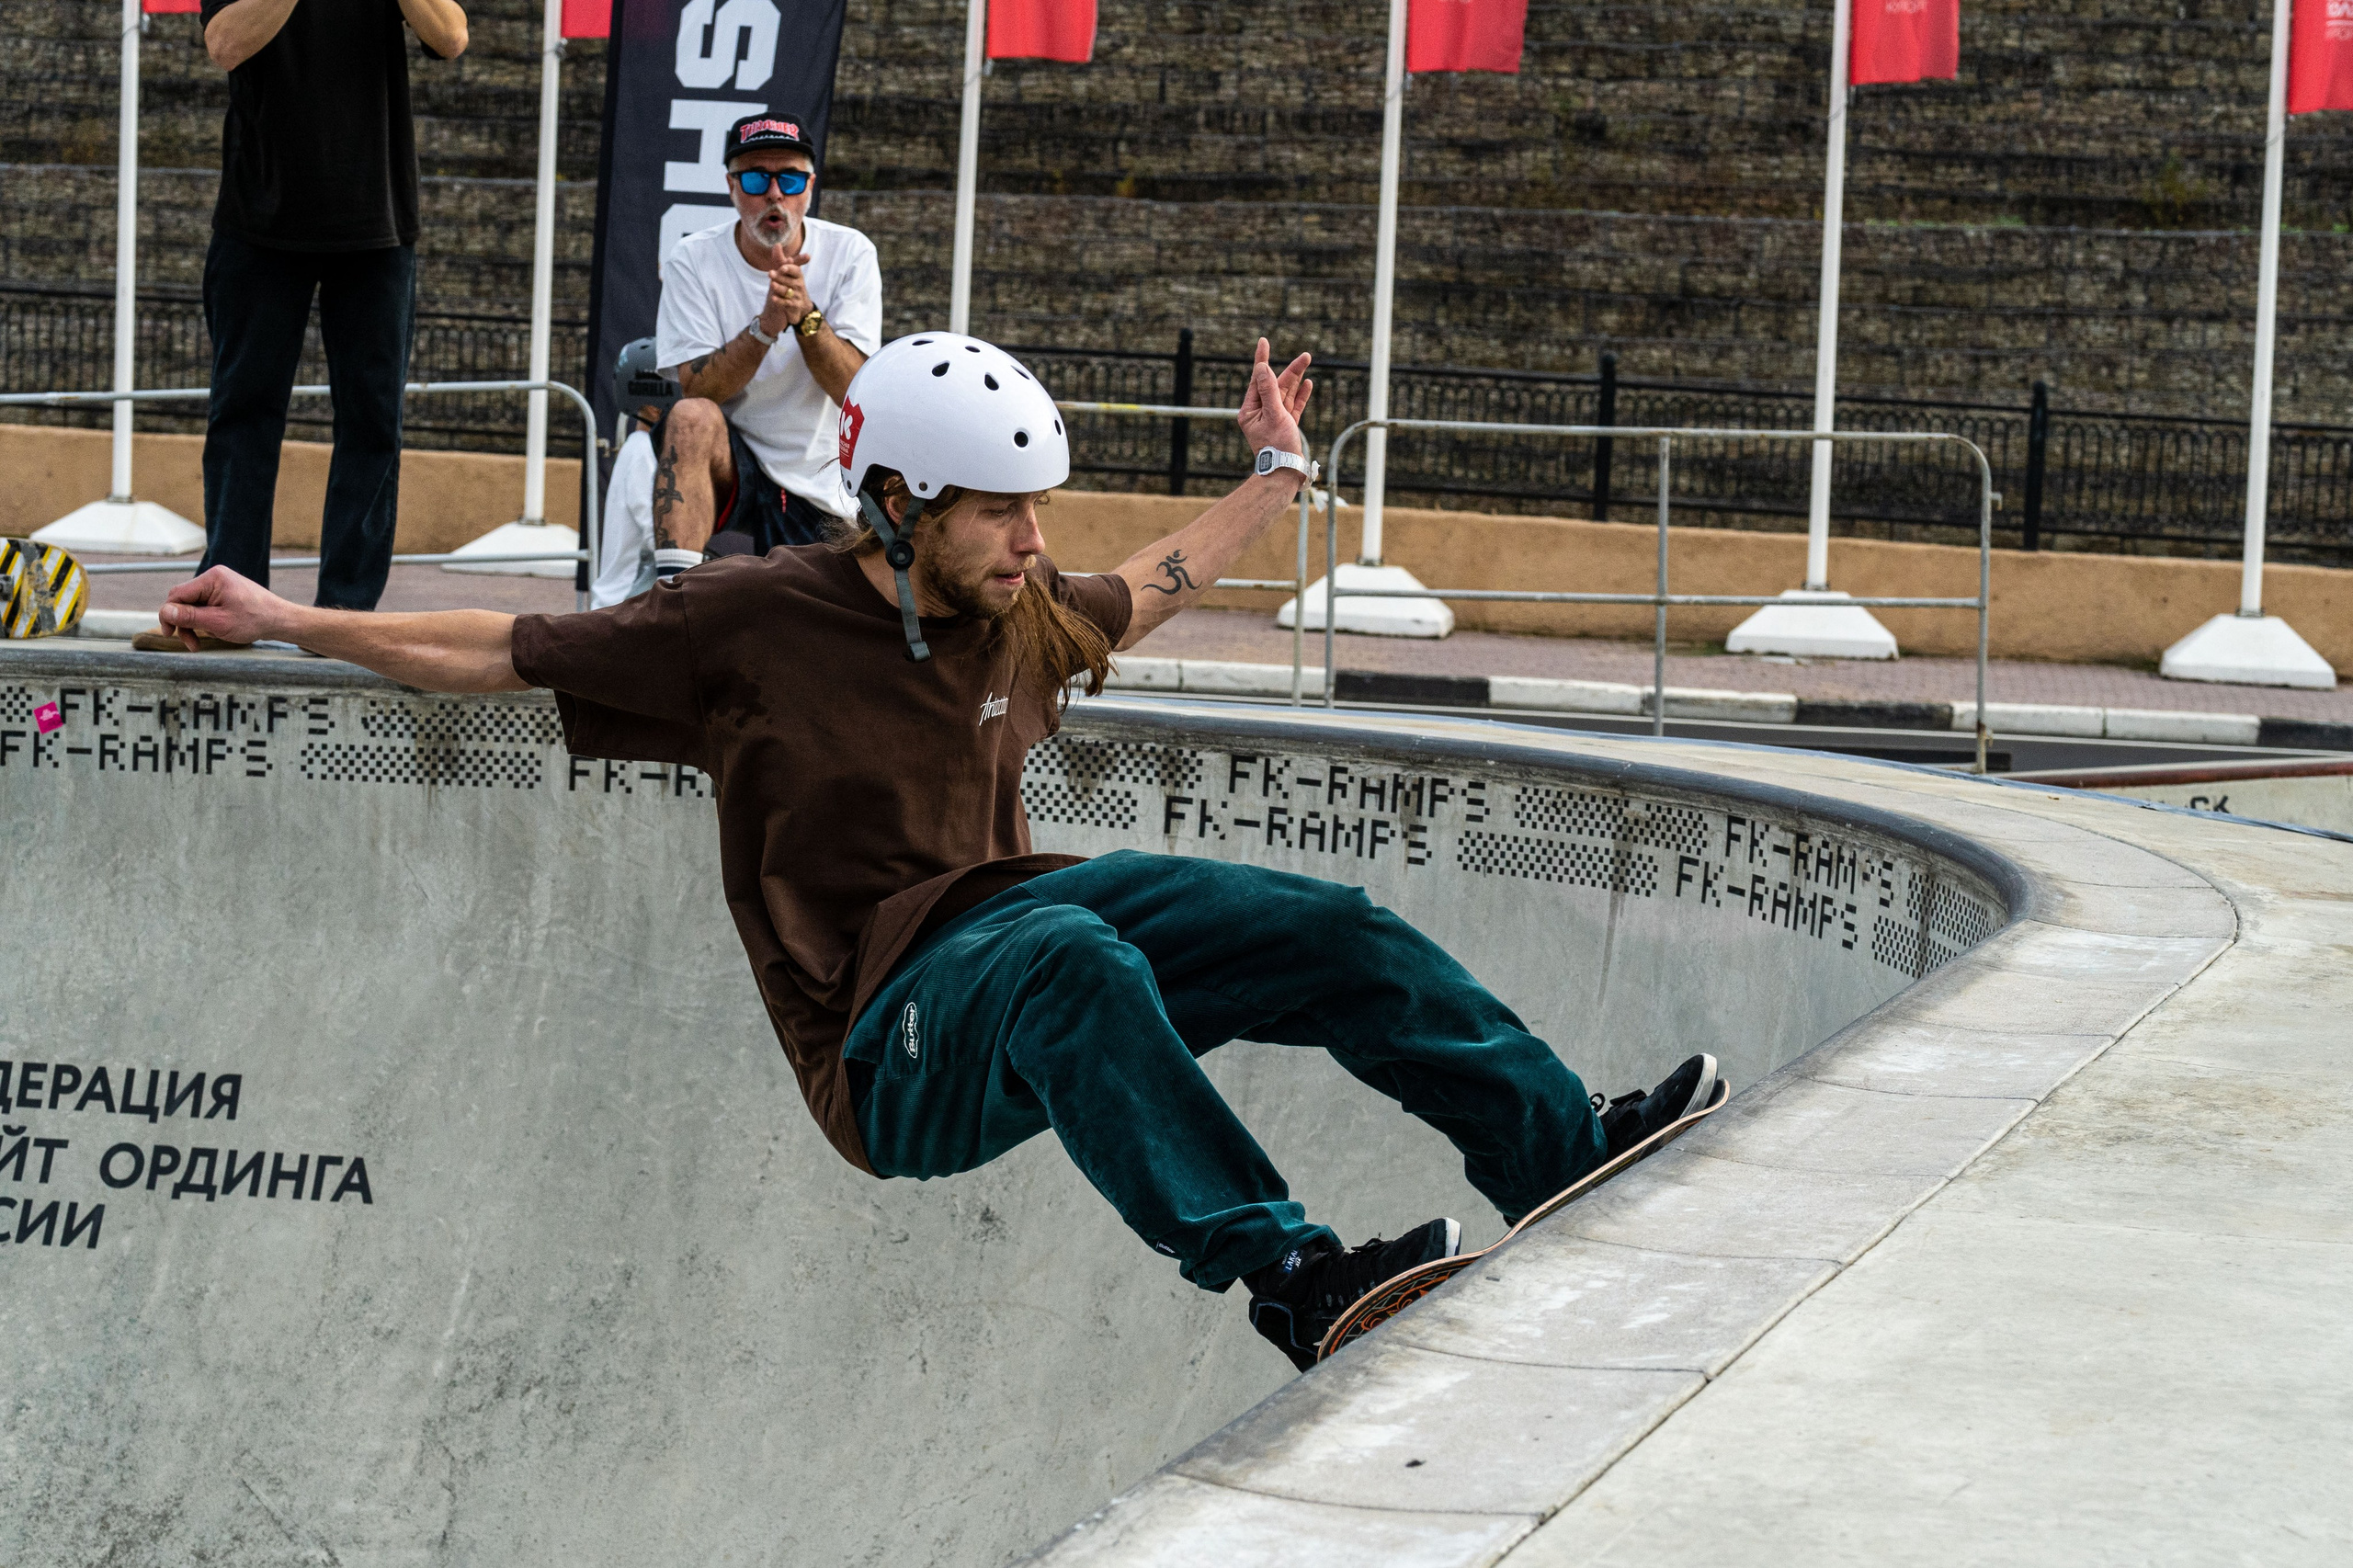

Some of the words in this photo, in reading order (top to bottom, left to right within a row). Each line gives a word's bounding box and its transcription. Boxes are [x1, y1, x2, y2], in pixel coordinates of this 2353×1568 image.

[0, 730, 273, 778] FK-RAMPS
[569, 755, 716, 798] FK-R
[1164, 795, 1432, 866] FK-RAMPS
[1676, 855, 1858, 950] FK-RAMPS
[99, 1142, 373, 1204] ОРДИНГА
